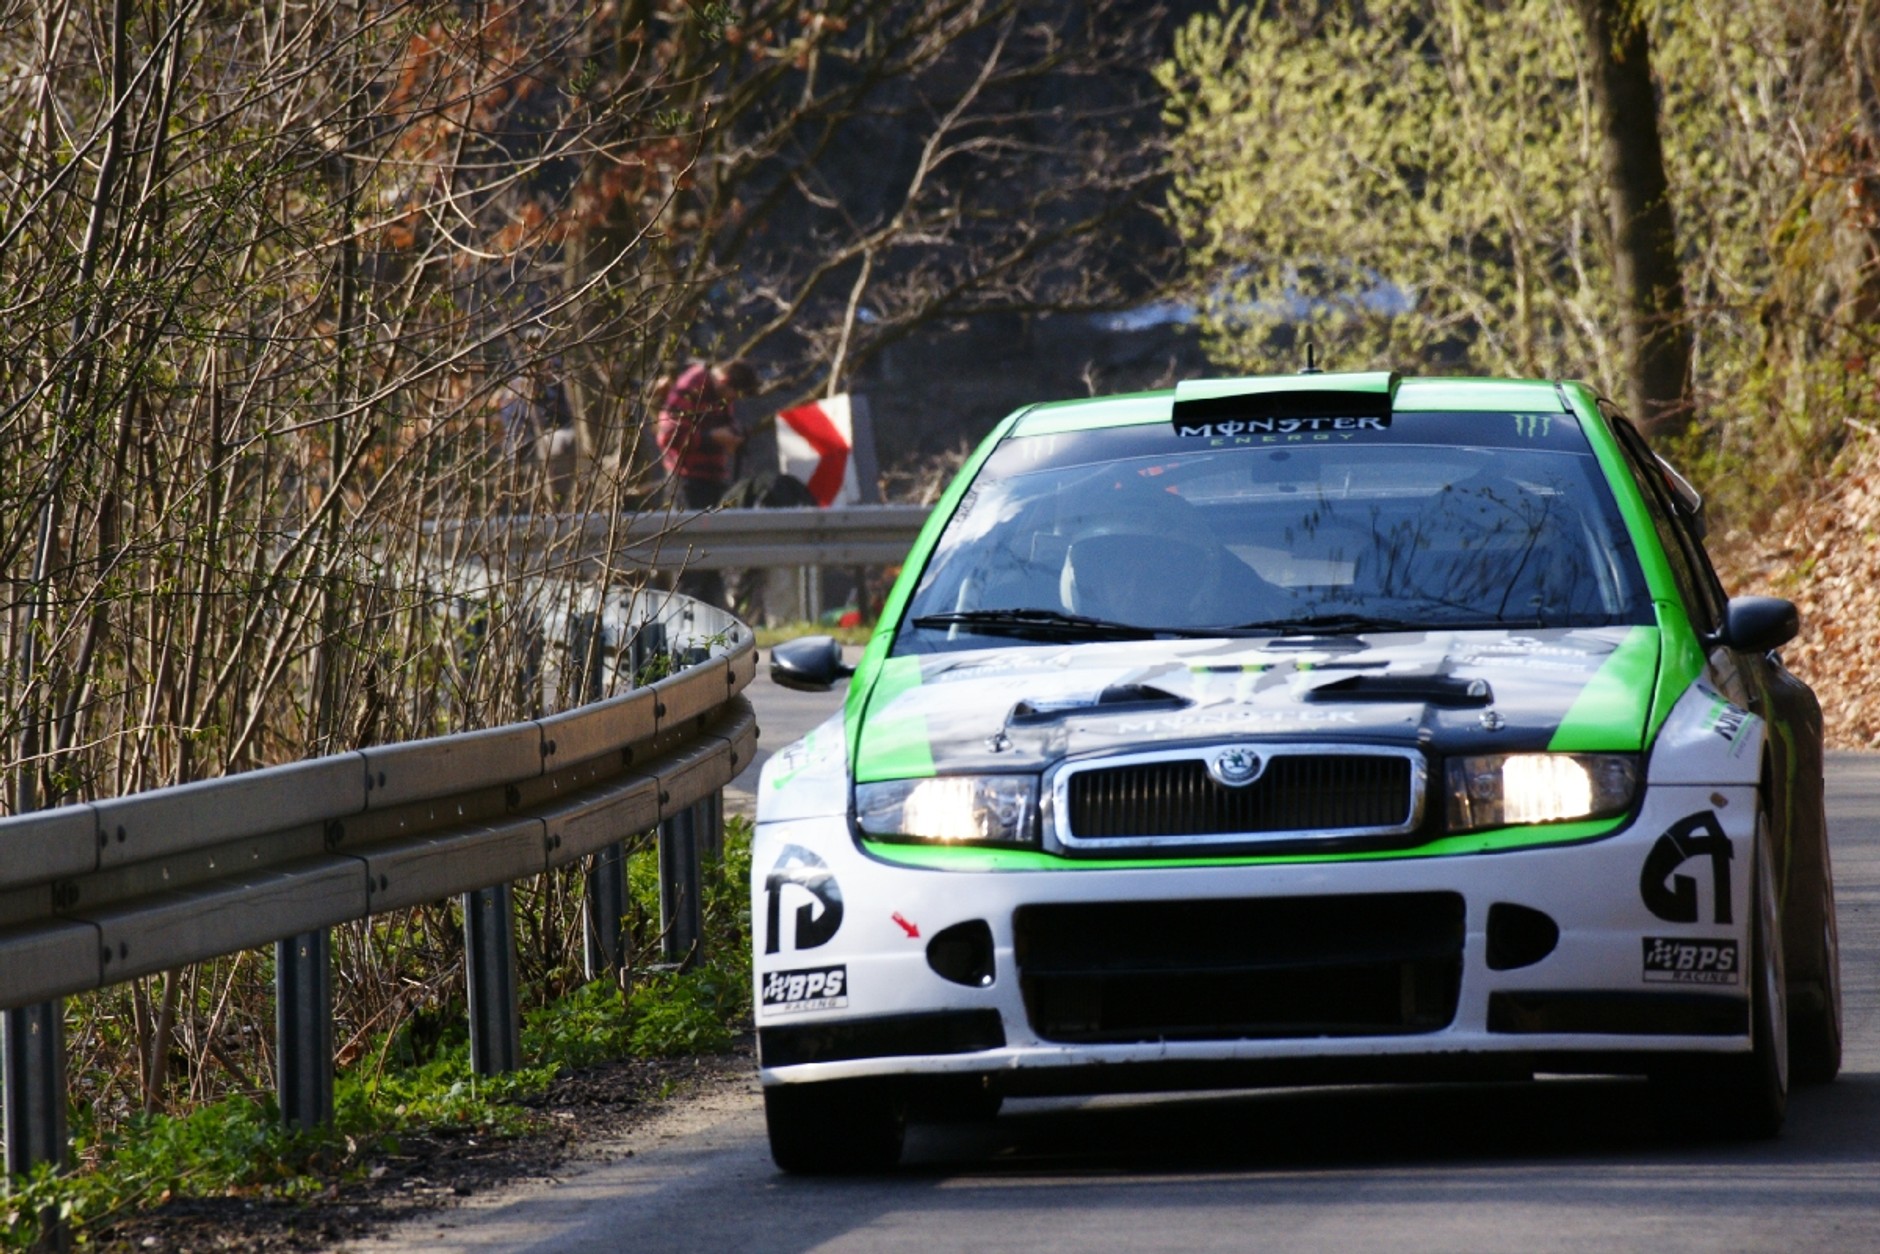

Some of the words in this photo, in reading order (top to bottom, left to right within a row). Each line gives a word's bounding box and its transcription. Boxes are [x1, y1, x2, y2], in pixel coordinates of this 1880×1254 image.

[1210, 433, 1354, 446] ENERGY
[1676, 946, 1735, 970] BPS
[786, 970, 845, 1002] BPS
[784, 998, 838, 1011] RACING
